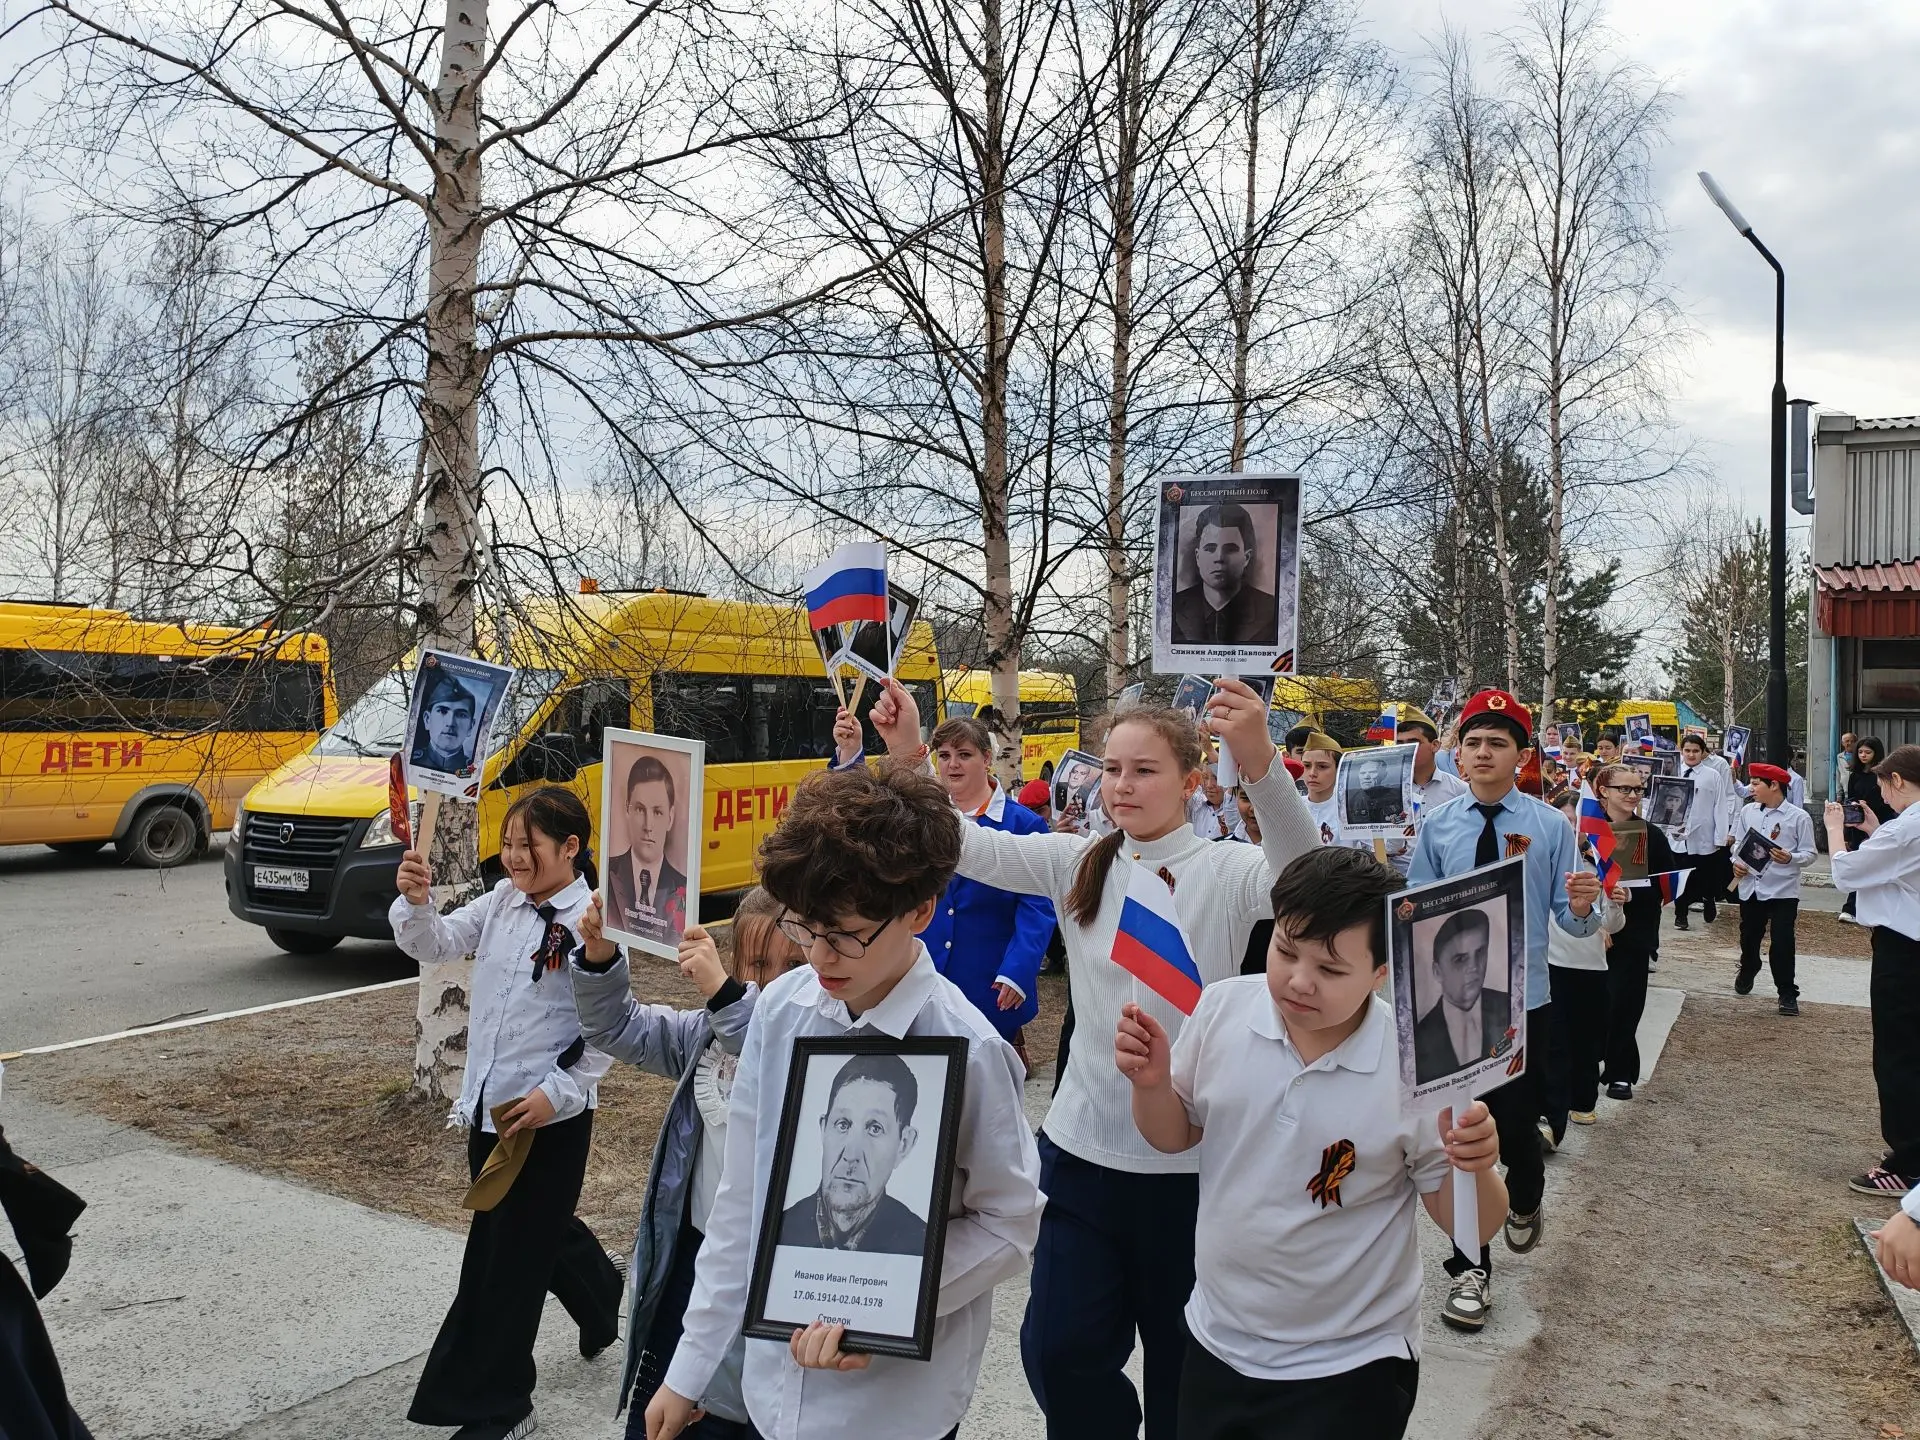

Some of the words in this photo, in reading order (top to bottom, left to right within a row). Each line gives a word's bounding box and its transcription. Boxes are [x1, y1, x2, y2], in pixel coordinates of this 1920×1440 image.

[1207, 648, 1236, 657] Андрей
[1237, 649, 1277, 657] Павлович
[40, 740, 143, 774] ДЕТИ
[713, 785, 788, 832] ДЕТИ
[292, 871, 308, 883] 186
[794, 1269, 825, 1281] Иванов
[826, 1272, 847, 1284] Иван
[849, 1274, 888, 1287] Петрович
[793, 1290, 884, 1308] 17.06.1914-02.04.1978
[817, 1313, 852, 1326] Стрелок
